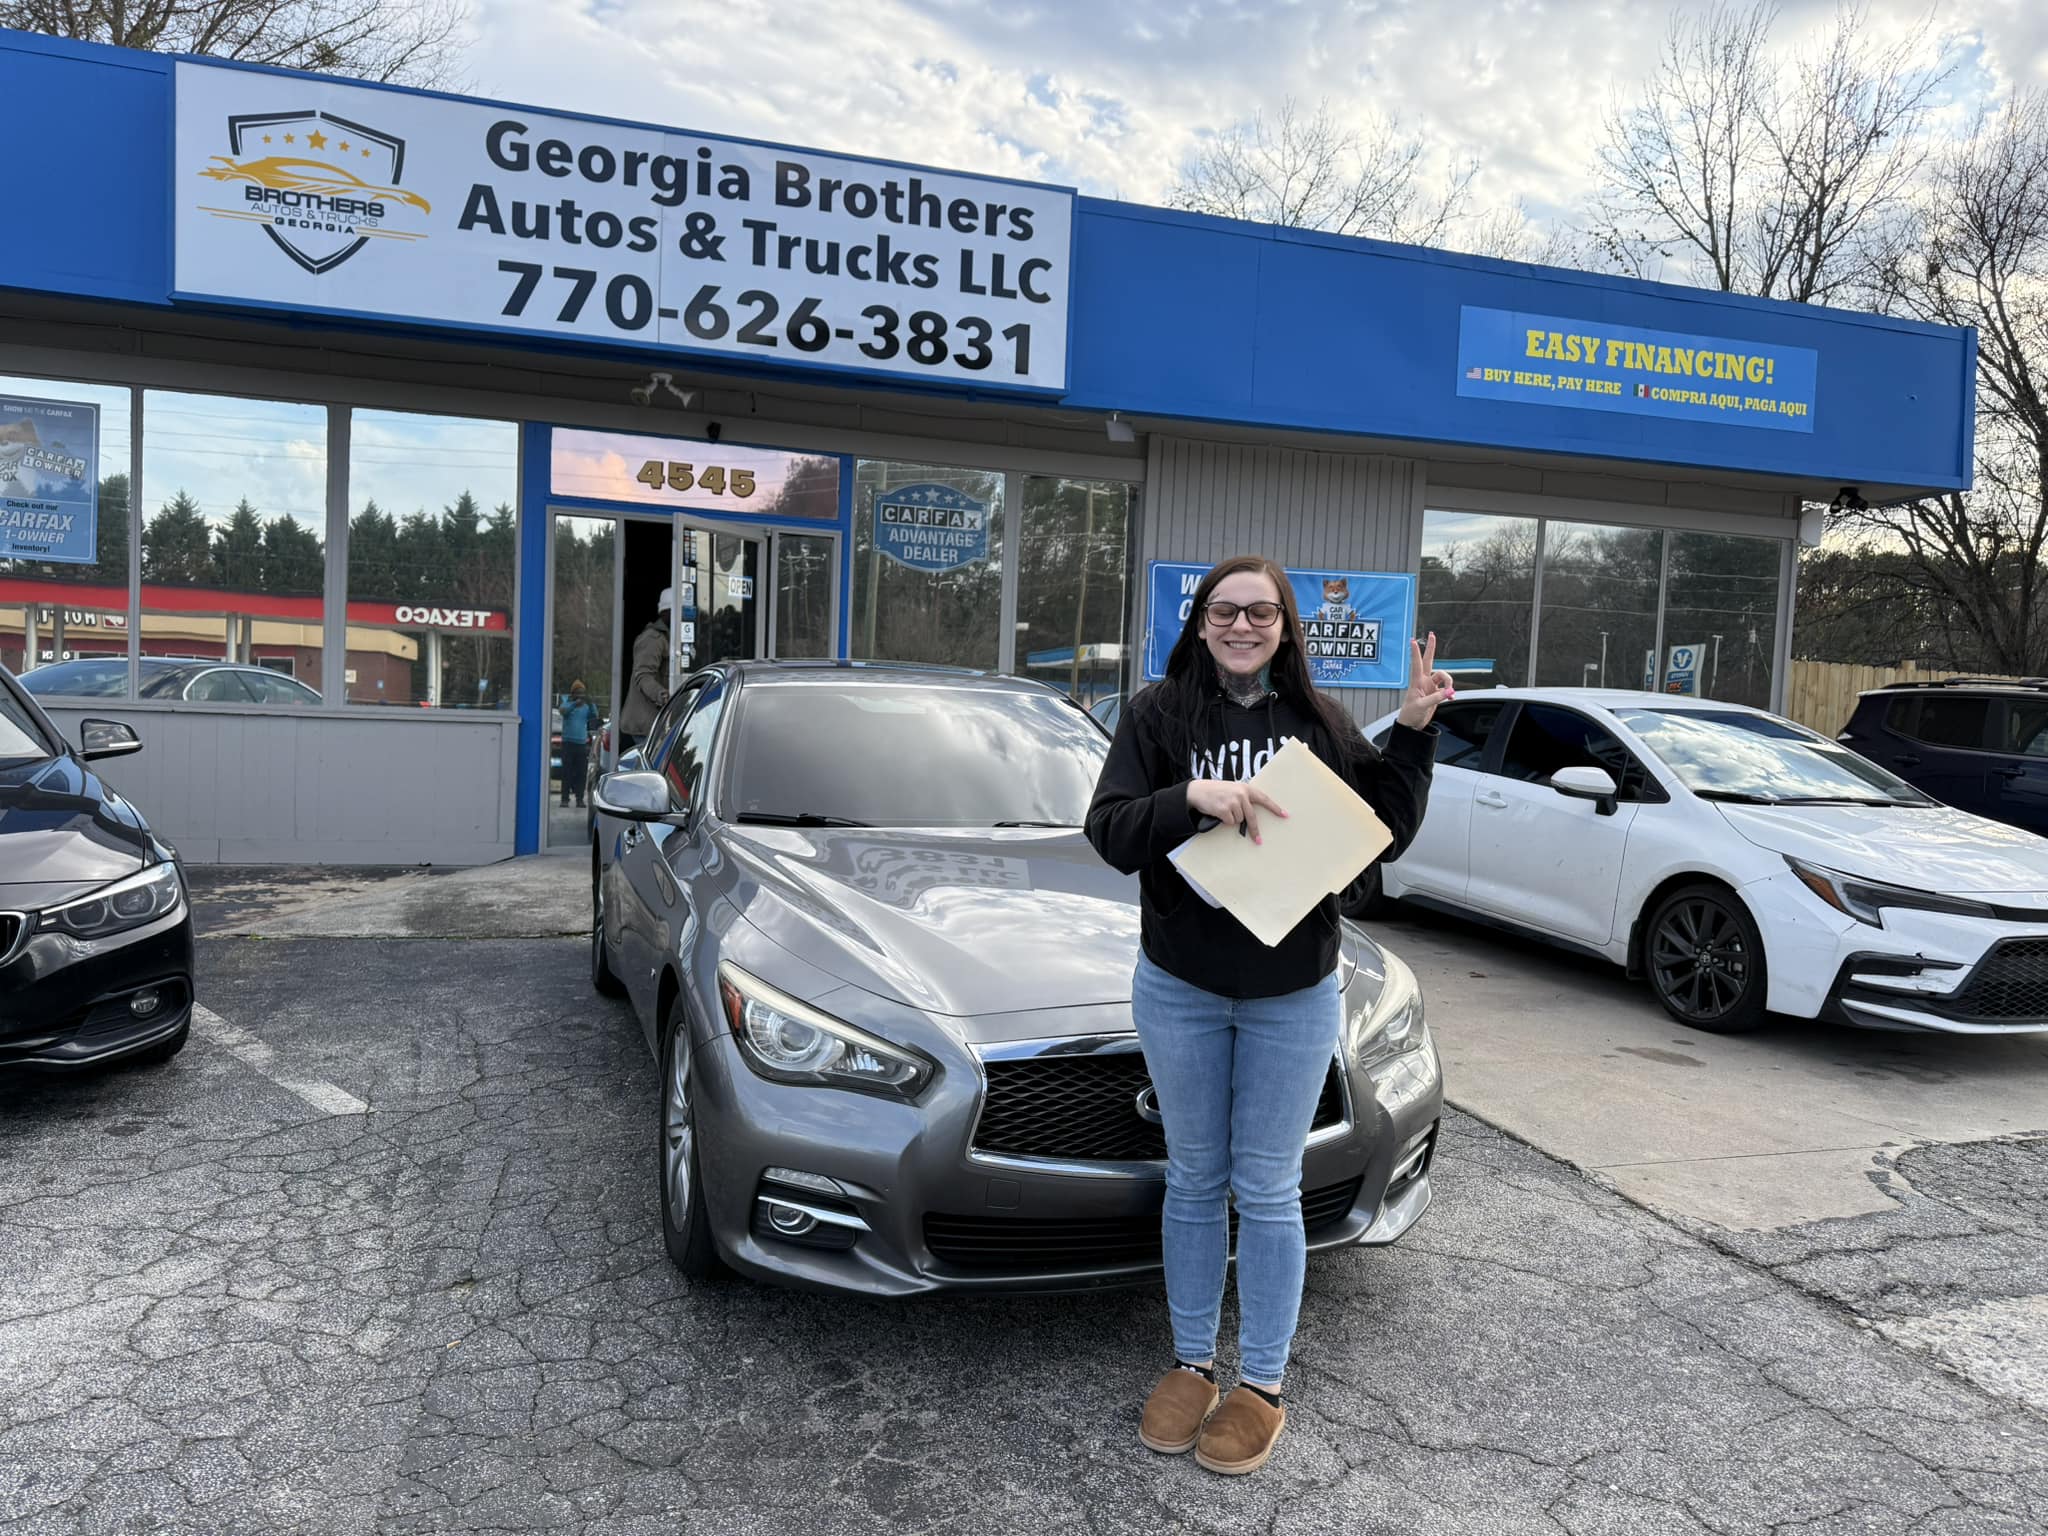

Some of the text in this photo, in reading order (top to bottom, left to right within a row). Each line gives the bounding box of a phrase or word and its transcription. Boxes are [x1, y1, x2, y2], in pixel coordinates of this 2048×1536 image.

[486, 120, 1035, 241] Georgia Brothers
[245, 185, 385, 218] BROTHERS
[251, 202, 379, 227] AUTOS & TRUCKS
[274, 217, 356, 234] GEORGIA
[457, 183, 1053, 304] Autos & Trucks LLC
[498, 259, 1031, 376] 770-626-3831
[1526, 329, 1774, 384] EASY FINANCING!
[1484, 367, 1622, 395] BUY HERE, PAY HERE
[1651, 387, 1808, 417] COMPRA AQUI, PAGA AQUI
[26, 447, 86, 471] CARFAX
[637, 460, 755, 498] 4545
[0, 509, 74, 531] CARFAX
[885, 507, 977, 529] CARFAX
[5, 529, 65, 544] 1-OWNER
[903, 545, 959, 563] DEALER
[730, 578, 752, 598] OPEN
[1308, 640, 1374, 656] OWNER
